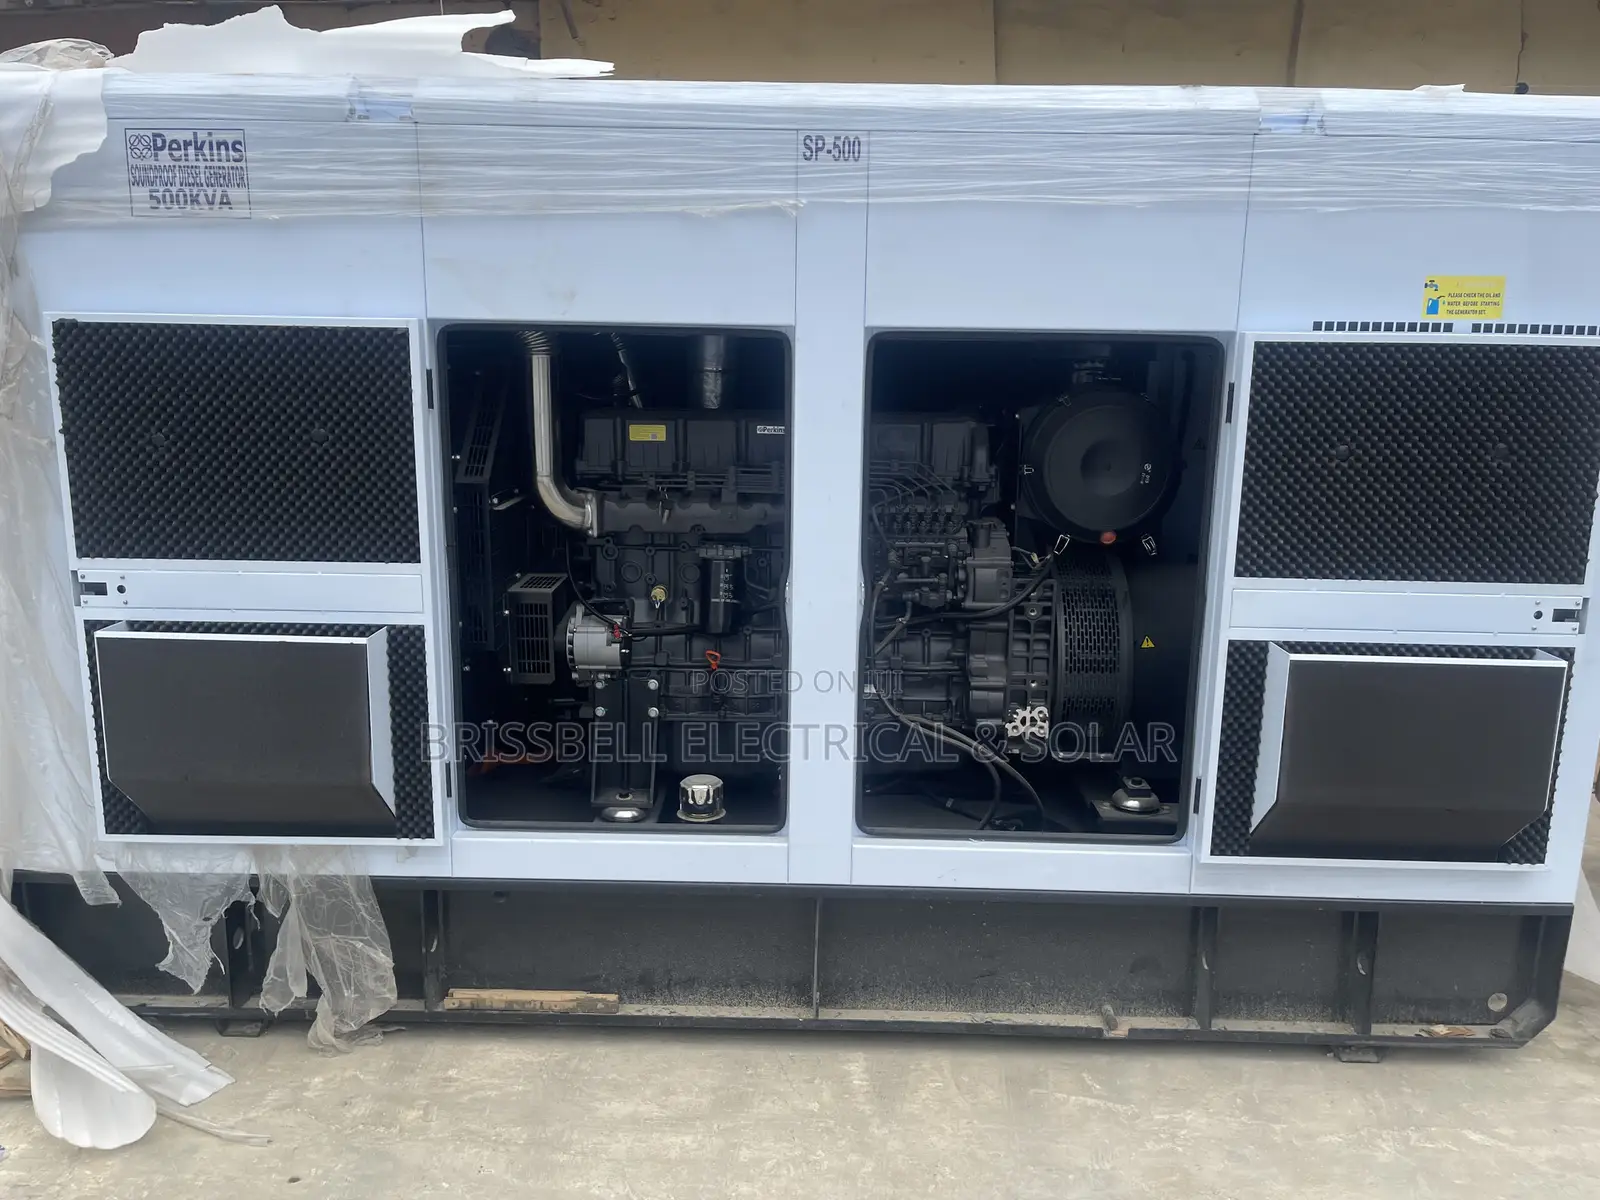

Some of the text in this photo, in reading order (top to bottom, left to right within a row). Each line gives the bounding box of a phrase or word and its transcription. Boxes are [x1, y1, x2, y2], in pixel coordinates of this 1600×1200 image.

[152, 132, 244, 162] Perkins
[803, 135, 861, 162] SP-500
[130, 164, 247, 188] SOUNDPROOF DIESEL GENERATOR
[149, 188, 233, 210] 500KVA
